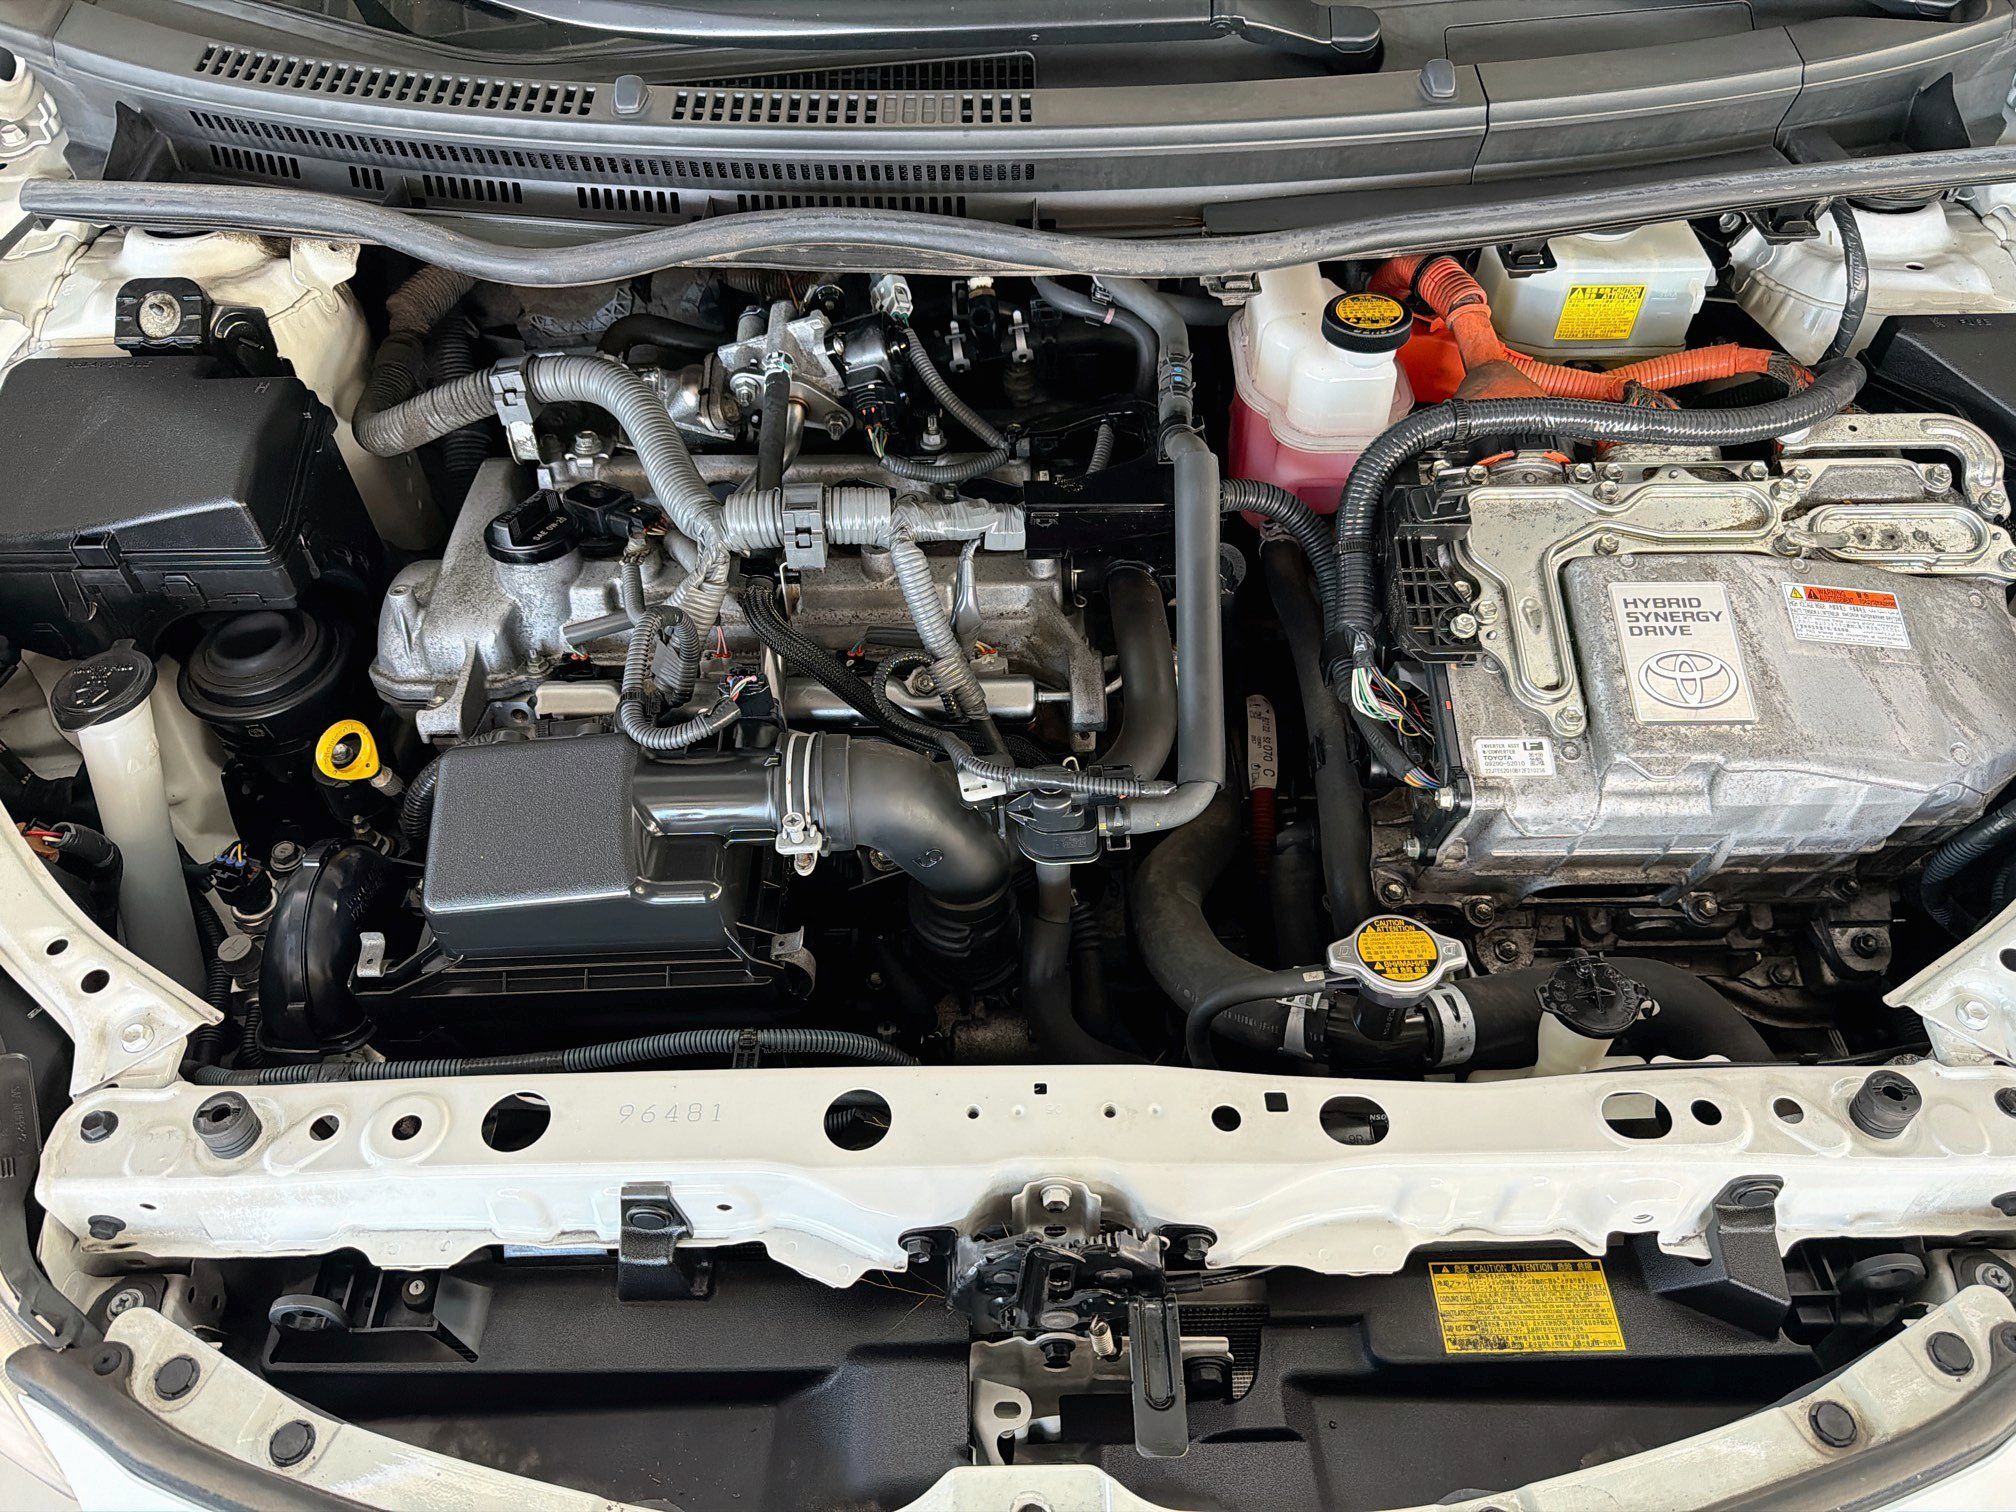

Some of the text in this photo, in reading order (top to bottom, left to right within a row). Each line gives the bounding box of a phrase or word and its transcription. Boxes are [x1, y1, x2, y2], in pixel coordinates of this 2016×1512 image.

[532, 529, 548, 541] SAE
[1623, 597, 1702, 609] HYBRID
[1626, 611, 1723, 623] SYNERGY
[1629, 625, 1693, 637] DRIVE
[619, 1102, 721, 1123] 96481
[1473, 1264, 1506, 1273] CAUTION
[1511, 1263, 1553, 1272] ATTENTION
